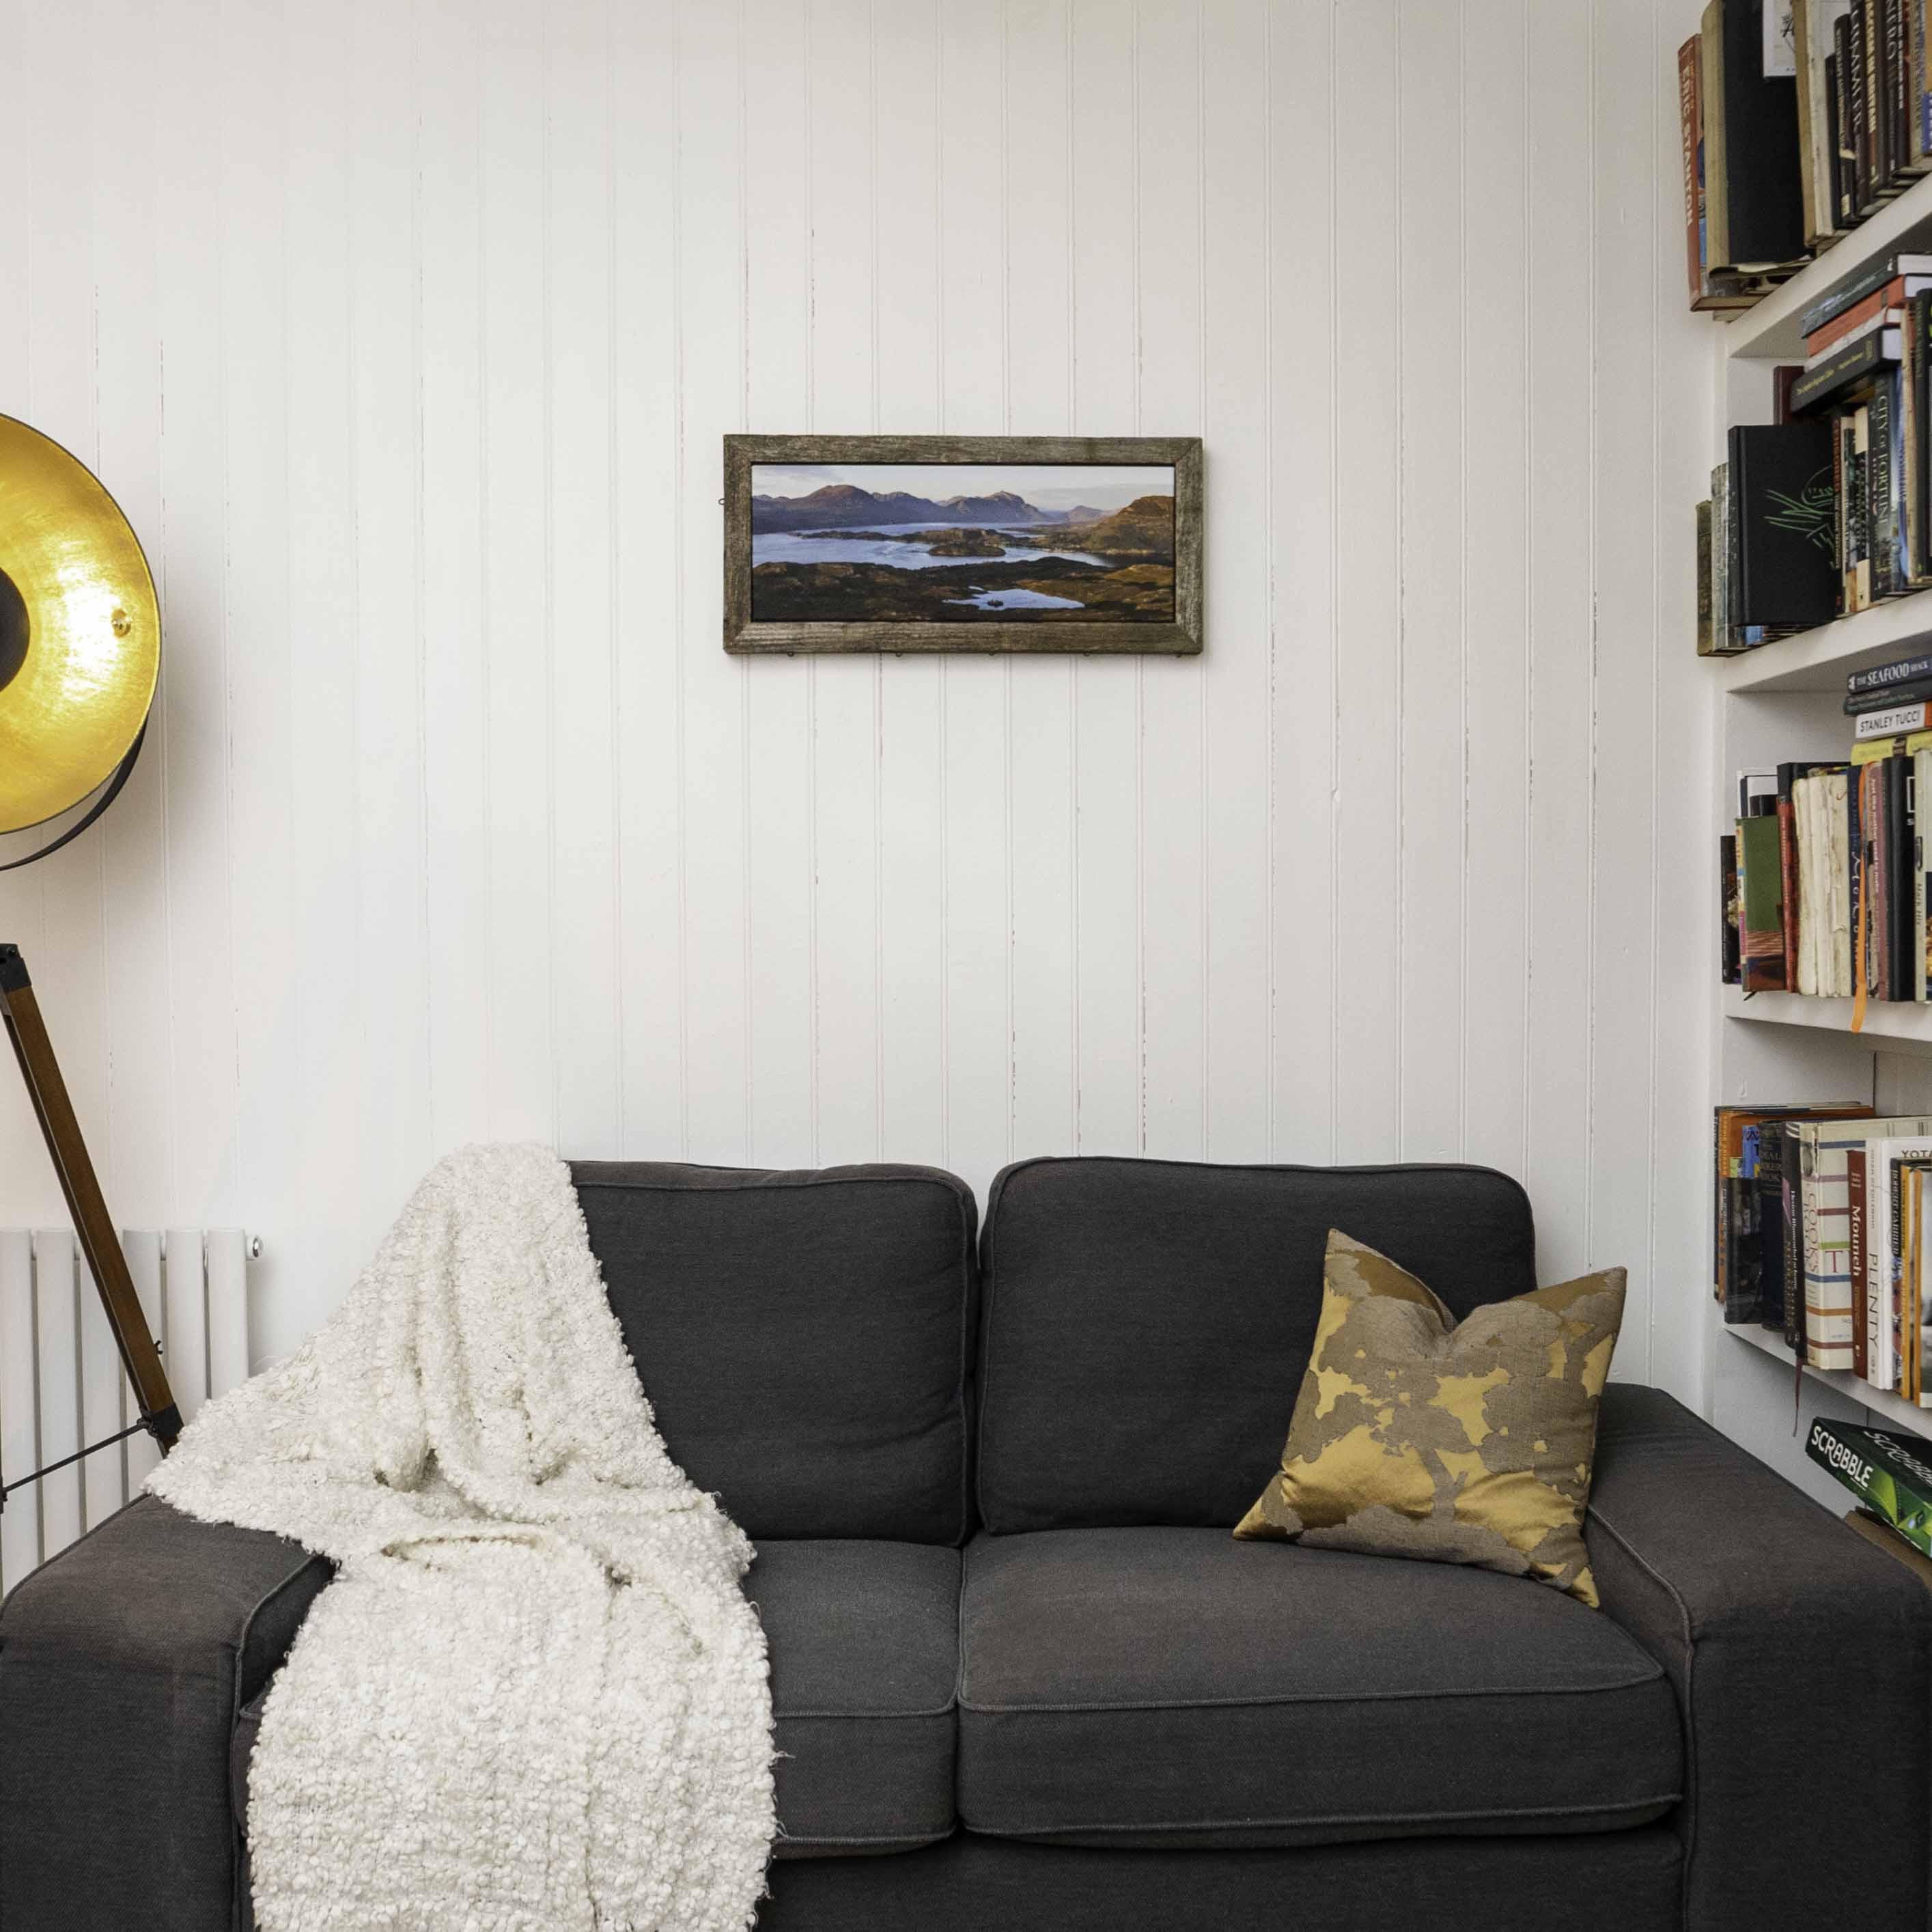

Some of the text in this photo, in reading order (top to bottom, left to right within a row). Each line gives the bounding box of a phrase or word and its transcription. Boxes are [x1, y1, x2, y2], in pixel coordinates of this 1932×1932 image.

[1868, 662, 1909, 686] SEAFOOD
[1860, 710, 1921, 733] STANLEY TUCCI
[1868, 1252, 1879, 1350] PLENTY
[1811, 1425, 1874, 1488] SCRABBLE
